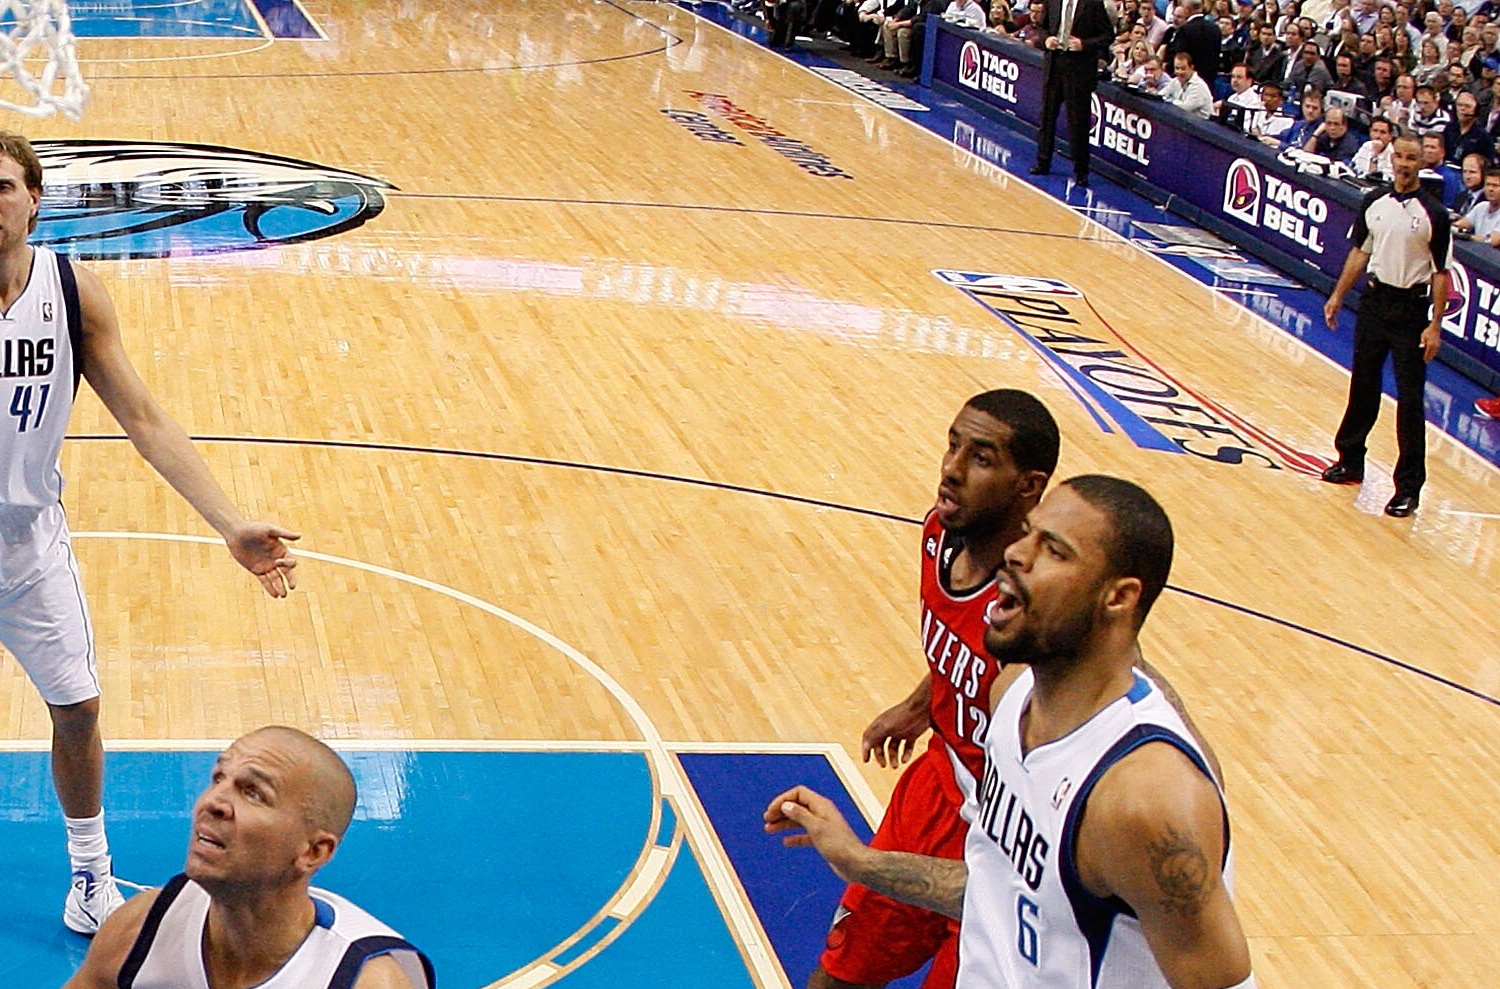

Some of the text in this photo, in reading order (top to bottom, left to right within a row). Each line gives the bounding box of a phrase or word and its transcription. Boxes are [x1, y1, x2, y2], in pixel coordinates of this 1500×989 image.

[981, 49, 1020, 82] TACO
[981, 71, 1018, 104] BELL
[1103, 101, 1152, 140] TACO
[1103, 127, 1150, 166] BELL
[1264, 174, 1328, 223] TACO
[1263, 203, 1325, 254] BELL
[968, 289, 1283, 470] PLAYOFFS
[9, 383, 52, 433] 41
[956, 692, 987, 749] 12
[1018, 893, 1040, 968] 6
